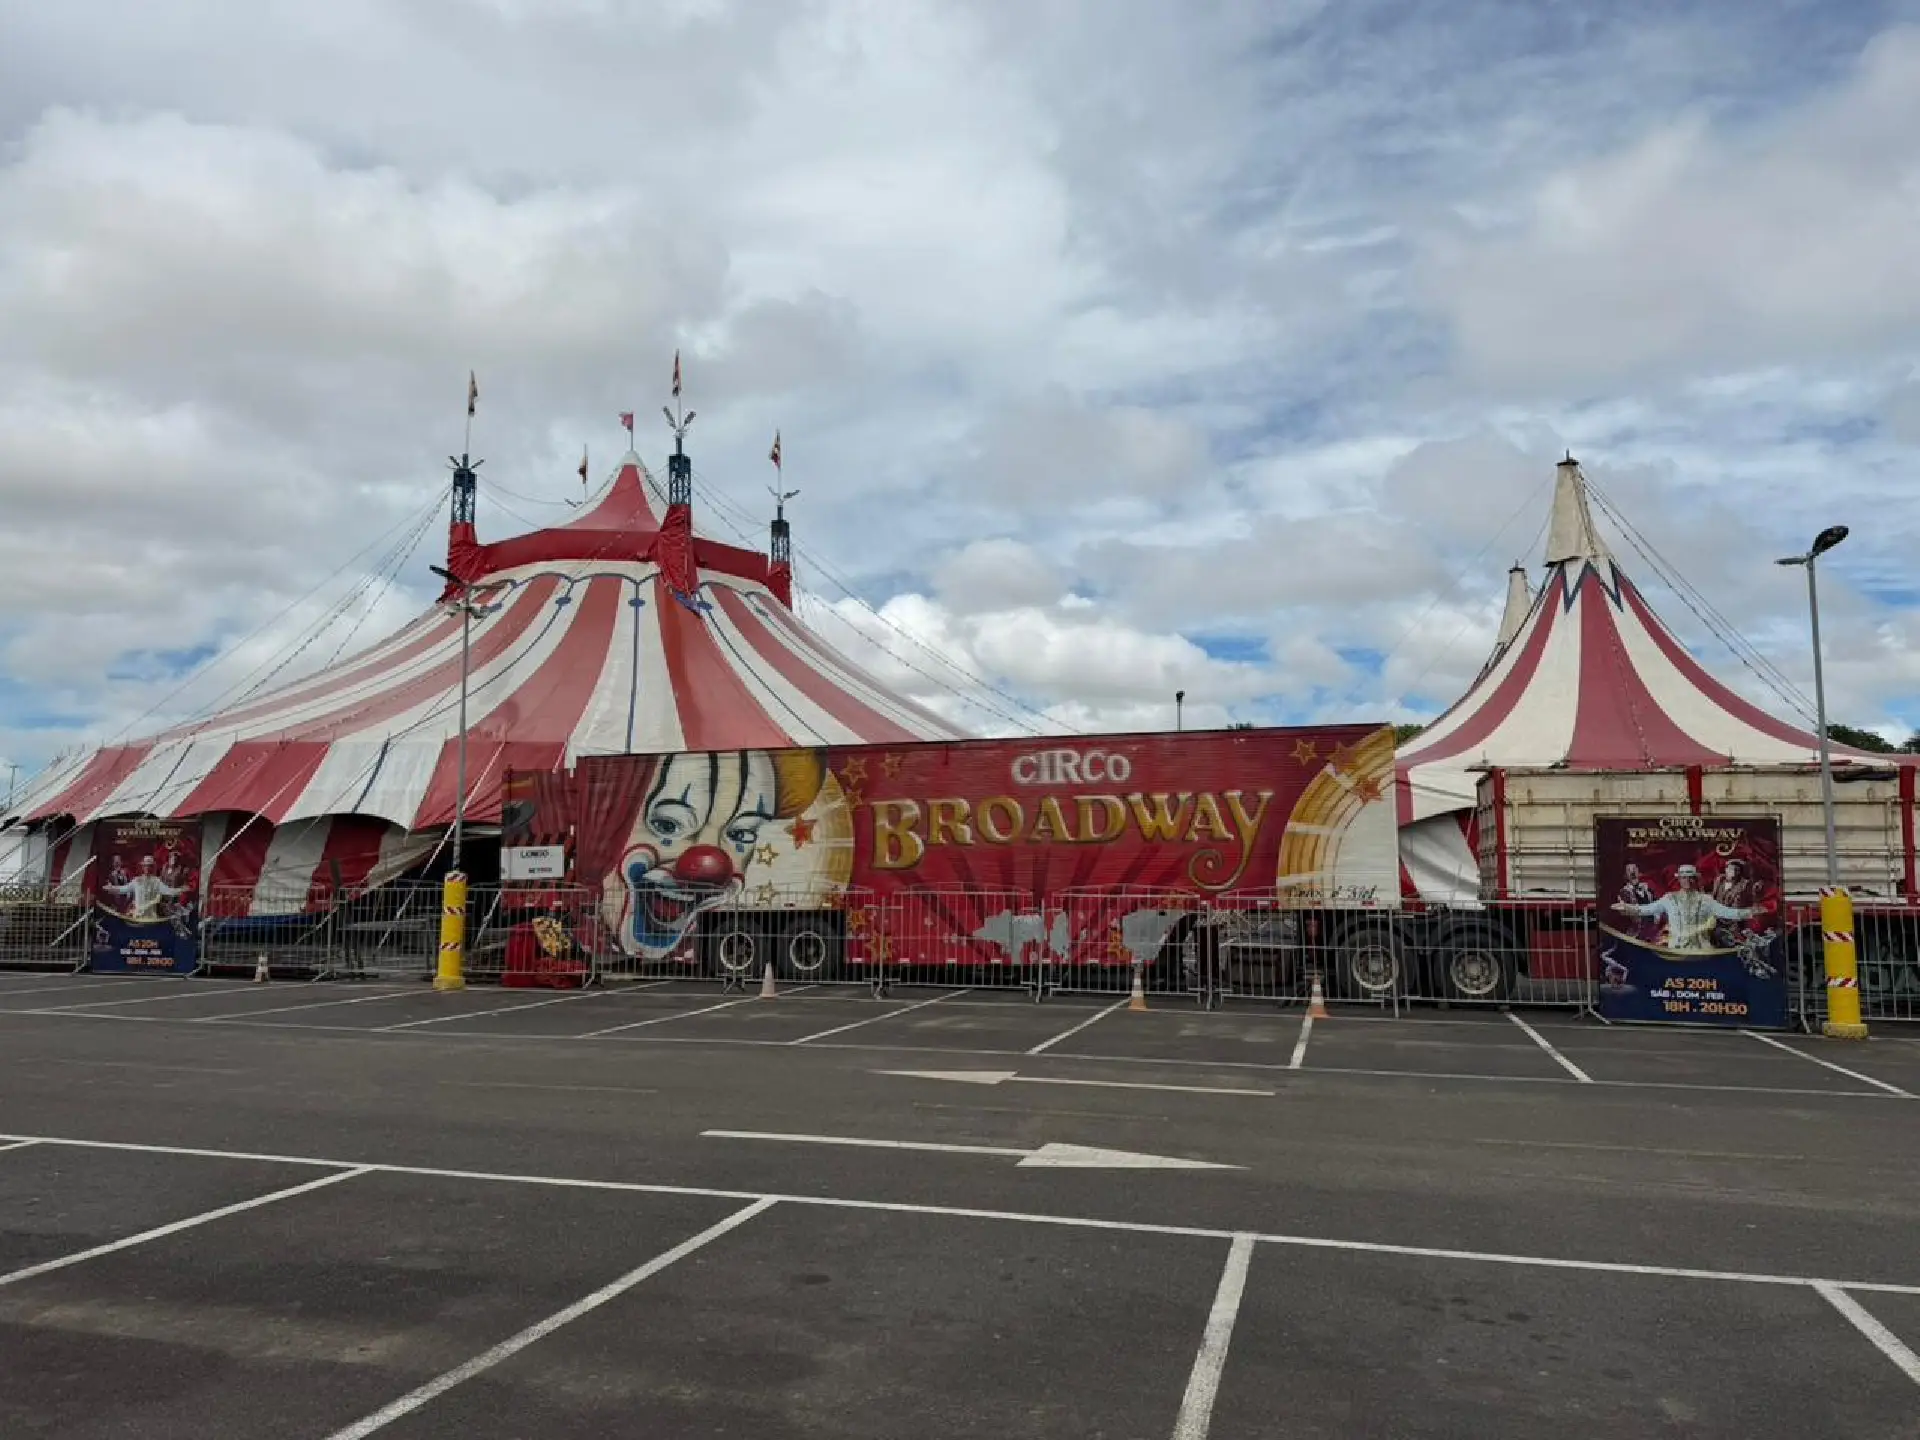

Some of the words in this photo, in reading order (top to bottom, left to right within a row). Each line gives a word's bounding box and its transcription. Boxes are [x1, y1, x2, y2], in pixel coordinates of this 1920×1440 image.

[1011, 749, 1131, 785] CIRCO
[870, 788, 1275, 891] BROADWAY
[1686, 978, 1718, 990] 20H
